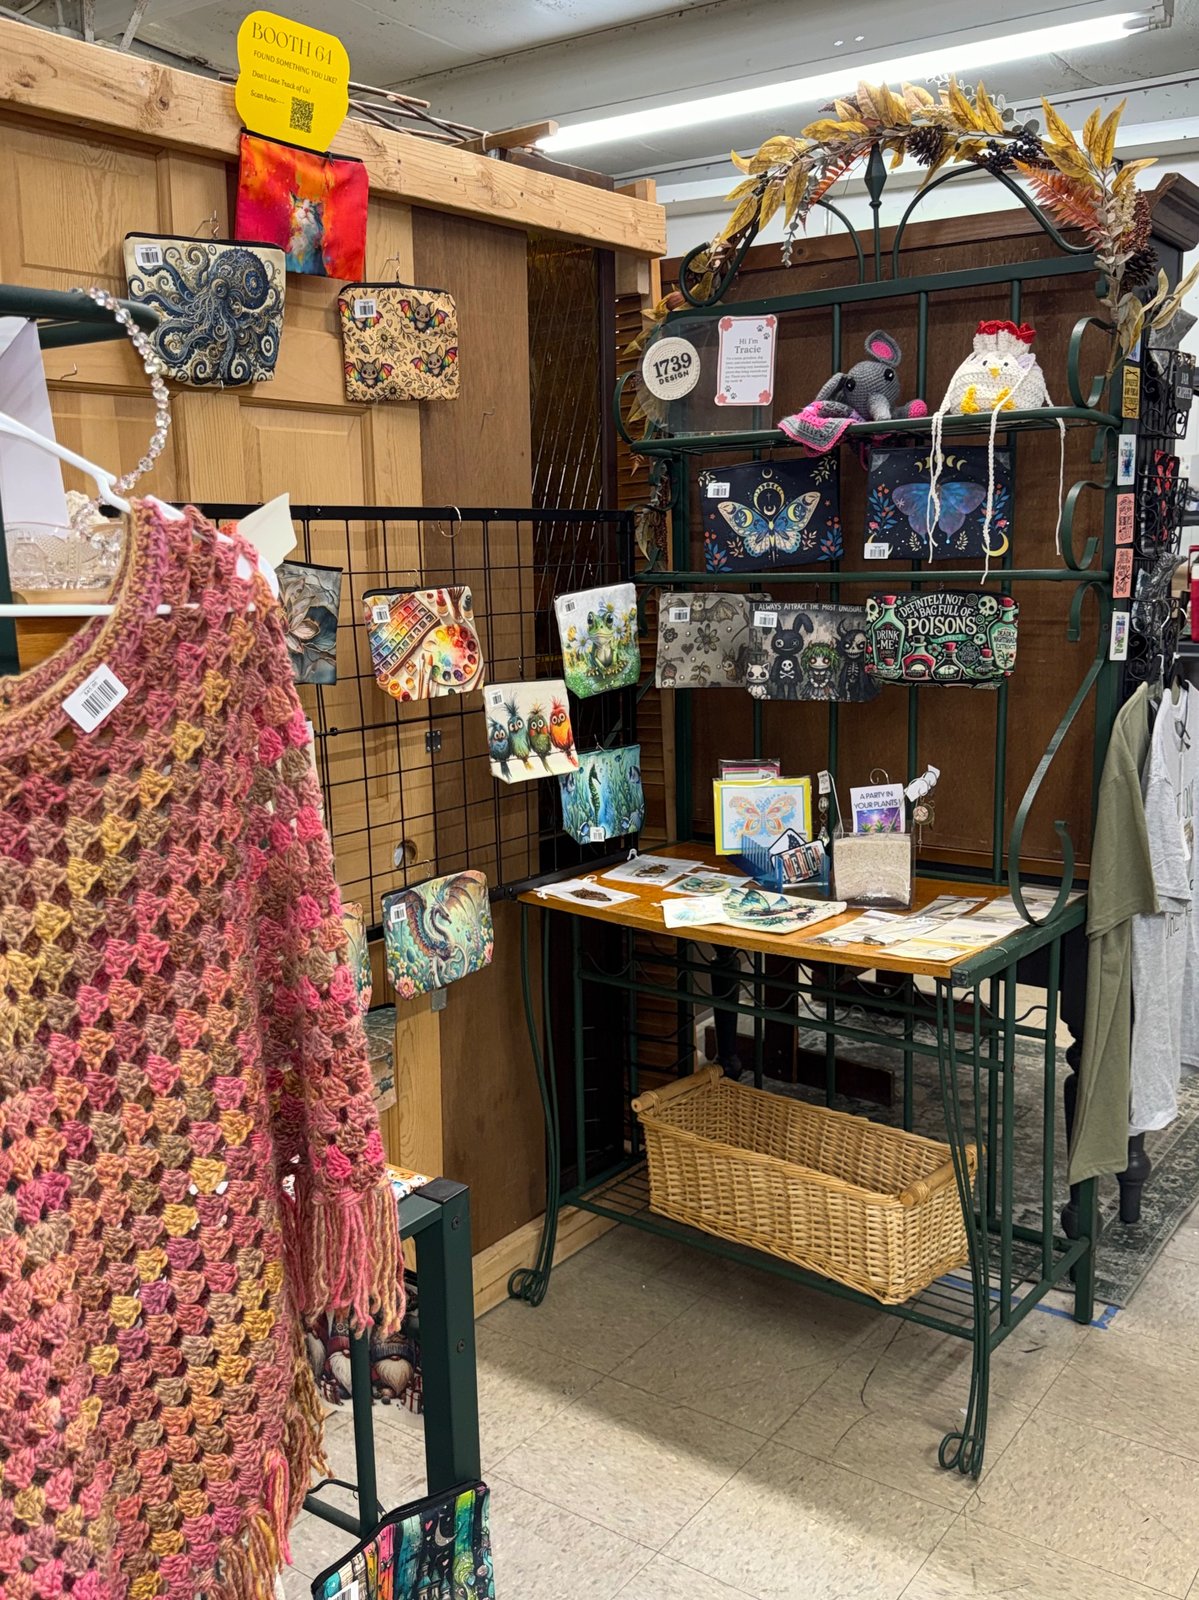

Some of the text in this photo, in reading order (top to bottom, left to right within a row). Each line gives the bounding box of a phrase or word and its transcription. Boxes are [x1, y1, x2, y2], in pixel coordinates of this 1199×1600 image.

[252, 22, 332, 65] BOOTH 64
[253, 49, 338, 84] FOUND SOMETHING YOU LIKE?
[252, 70, 267, 80] Don't
[268, 75, 280, 84] Lose
[281, 79, 296, 90] Track
[250, 89, 264, 100] Scan
[735, 345, 761, 354] Tracie
[653, 352, 692, 378] 1739
[659, 370, 689, 385] DESIGN
[946, 594, 965, 606] NOT
[758, 603, 781, 611] ALWAYS
[783, 603, 808, 611] ATTRACT
[838, 605, 863, 613] UNUSUAL
[919, 605, 937, 618] BAG
[938, 604, 958, 617] FULL
[960, 607, 974, 617] OF
[906, 616, 977, 637] POISONS
[876, 630, 899, 641] DRINK
[880, 640, 895, 650] ME
[873, 799, 898, 808] PLANTS
